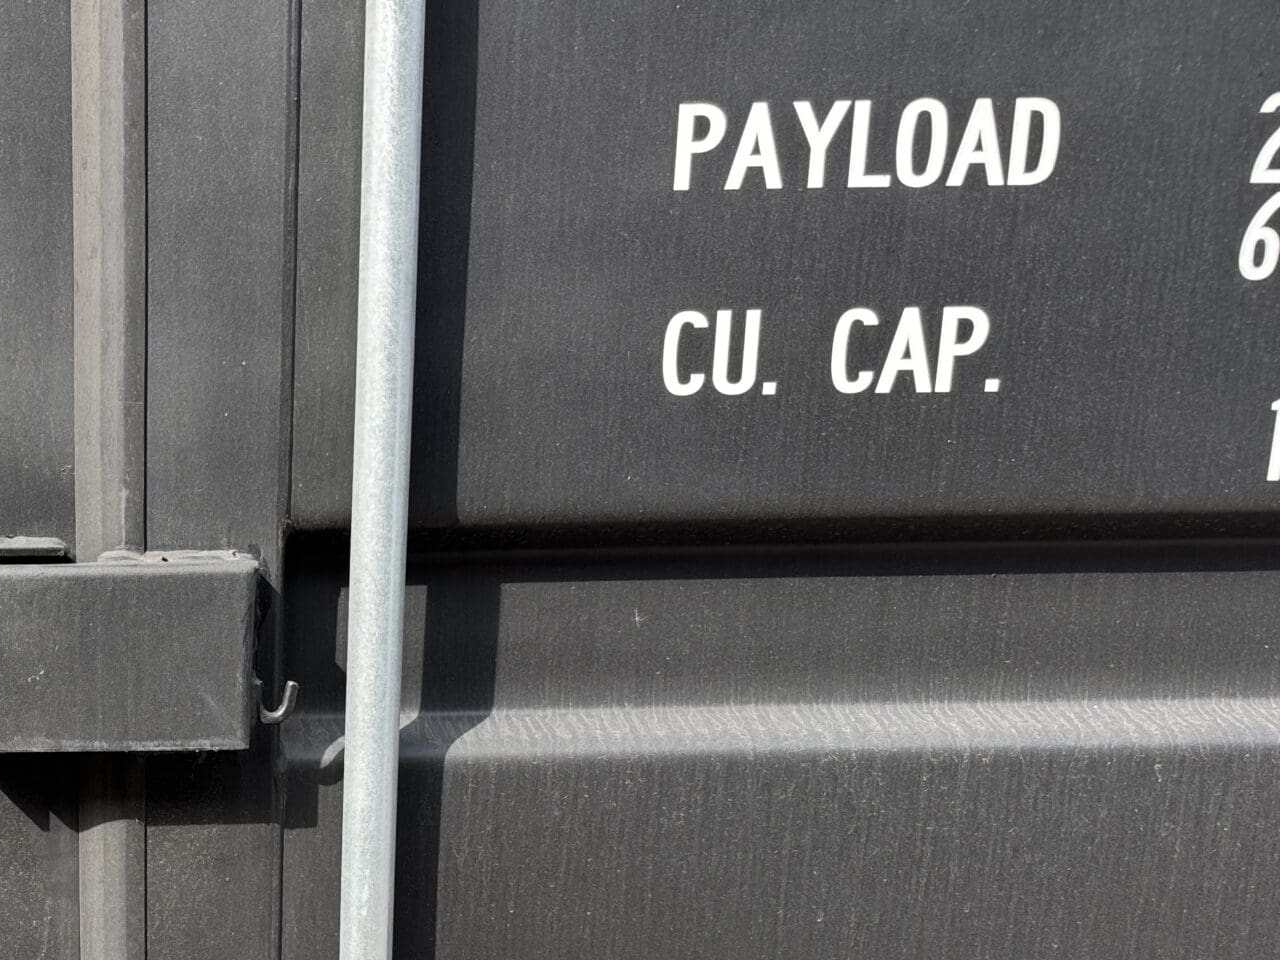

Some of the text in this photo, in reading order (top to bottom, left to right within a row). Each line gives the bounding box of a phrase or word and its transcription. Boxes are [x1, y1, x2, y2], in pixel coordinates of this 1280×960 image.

[673, 97, 1062, 191] PAYLOAD
[661, 306, 1001, 396] CU. CAP.
